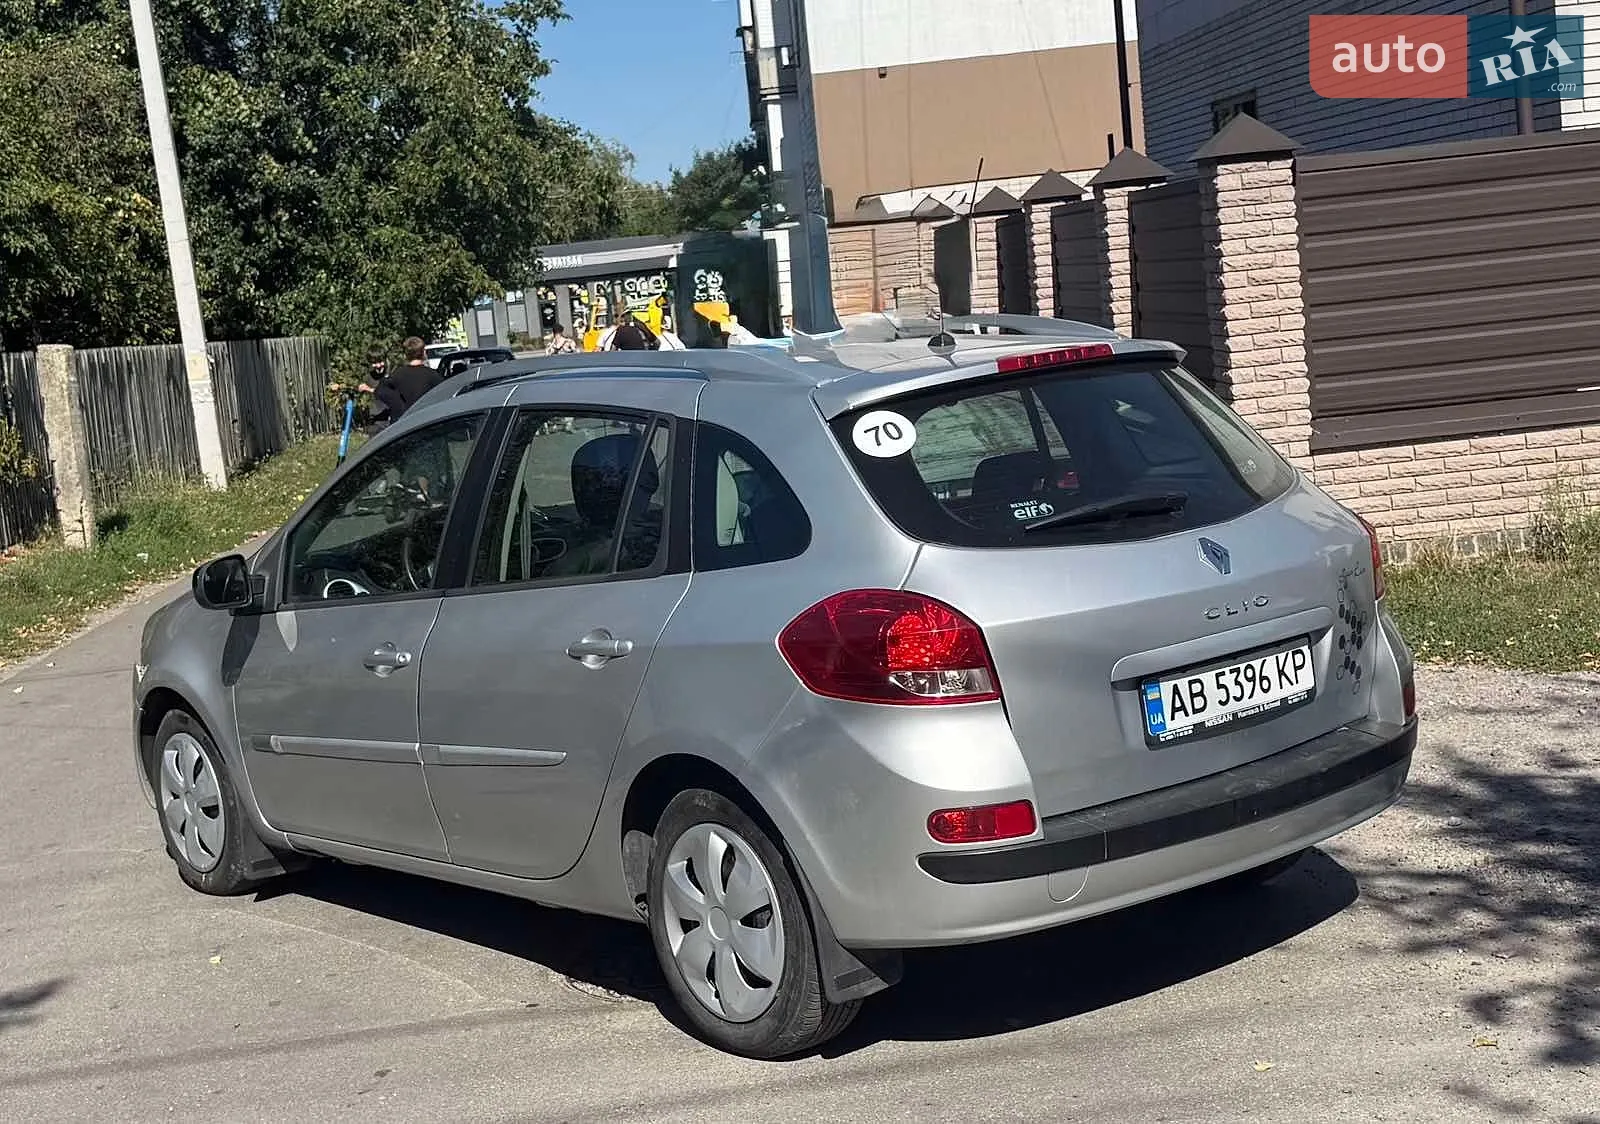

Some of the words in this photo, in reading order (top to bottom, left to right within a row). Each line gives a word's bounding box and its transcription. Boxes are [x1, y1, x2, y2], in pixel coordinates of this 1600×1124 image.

[863, 421, 903, 447] 70
[1013, 505, 1038, 519] elf
[1203, 595, 1269, 620] CLIO
[1170, 678, 1208, 721] AB
[1215, 659, 1272, 707] 5396
[1275, 649, 1306, 690] KP
[1150, 712, 1164, 725] UA
[1204, 713, 1233, 728] NISSAN
